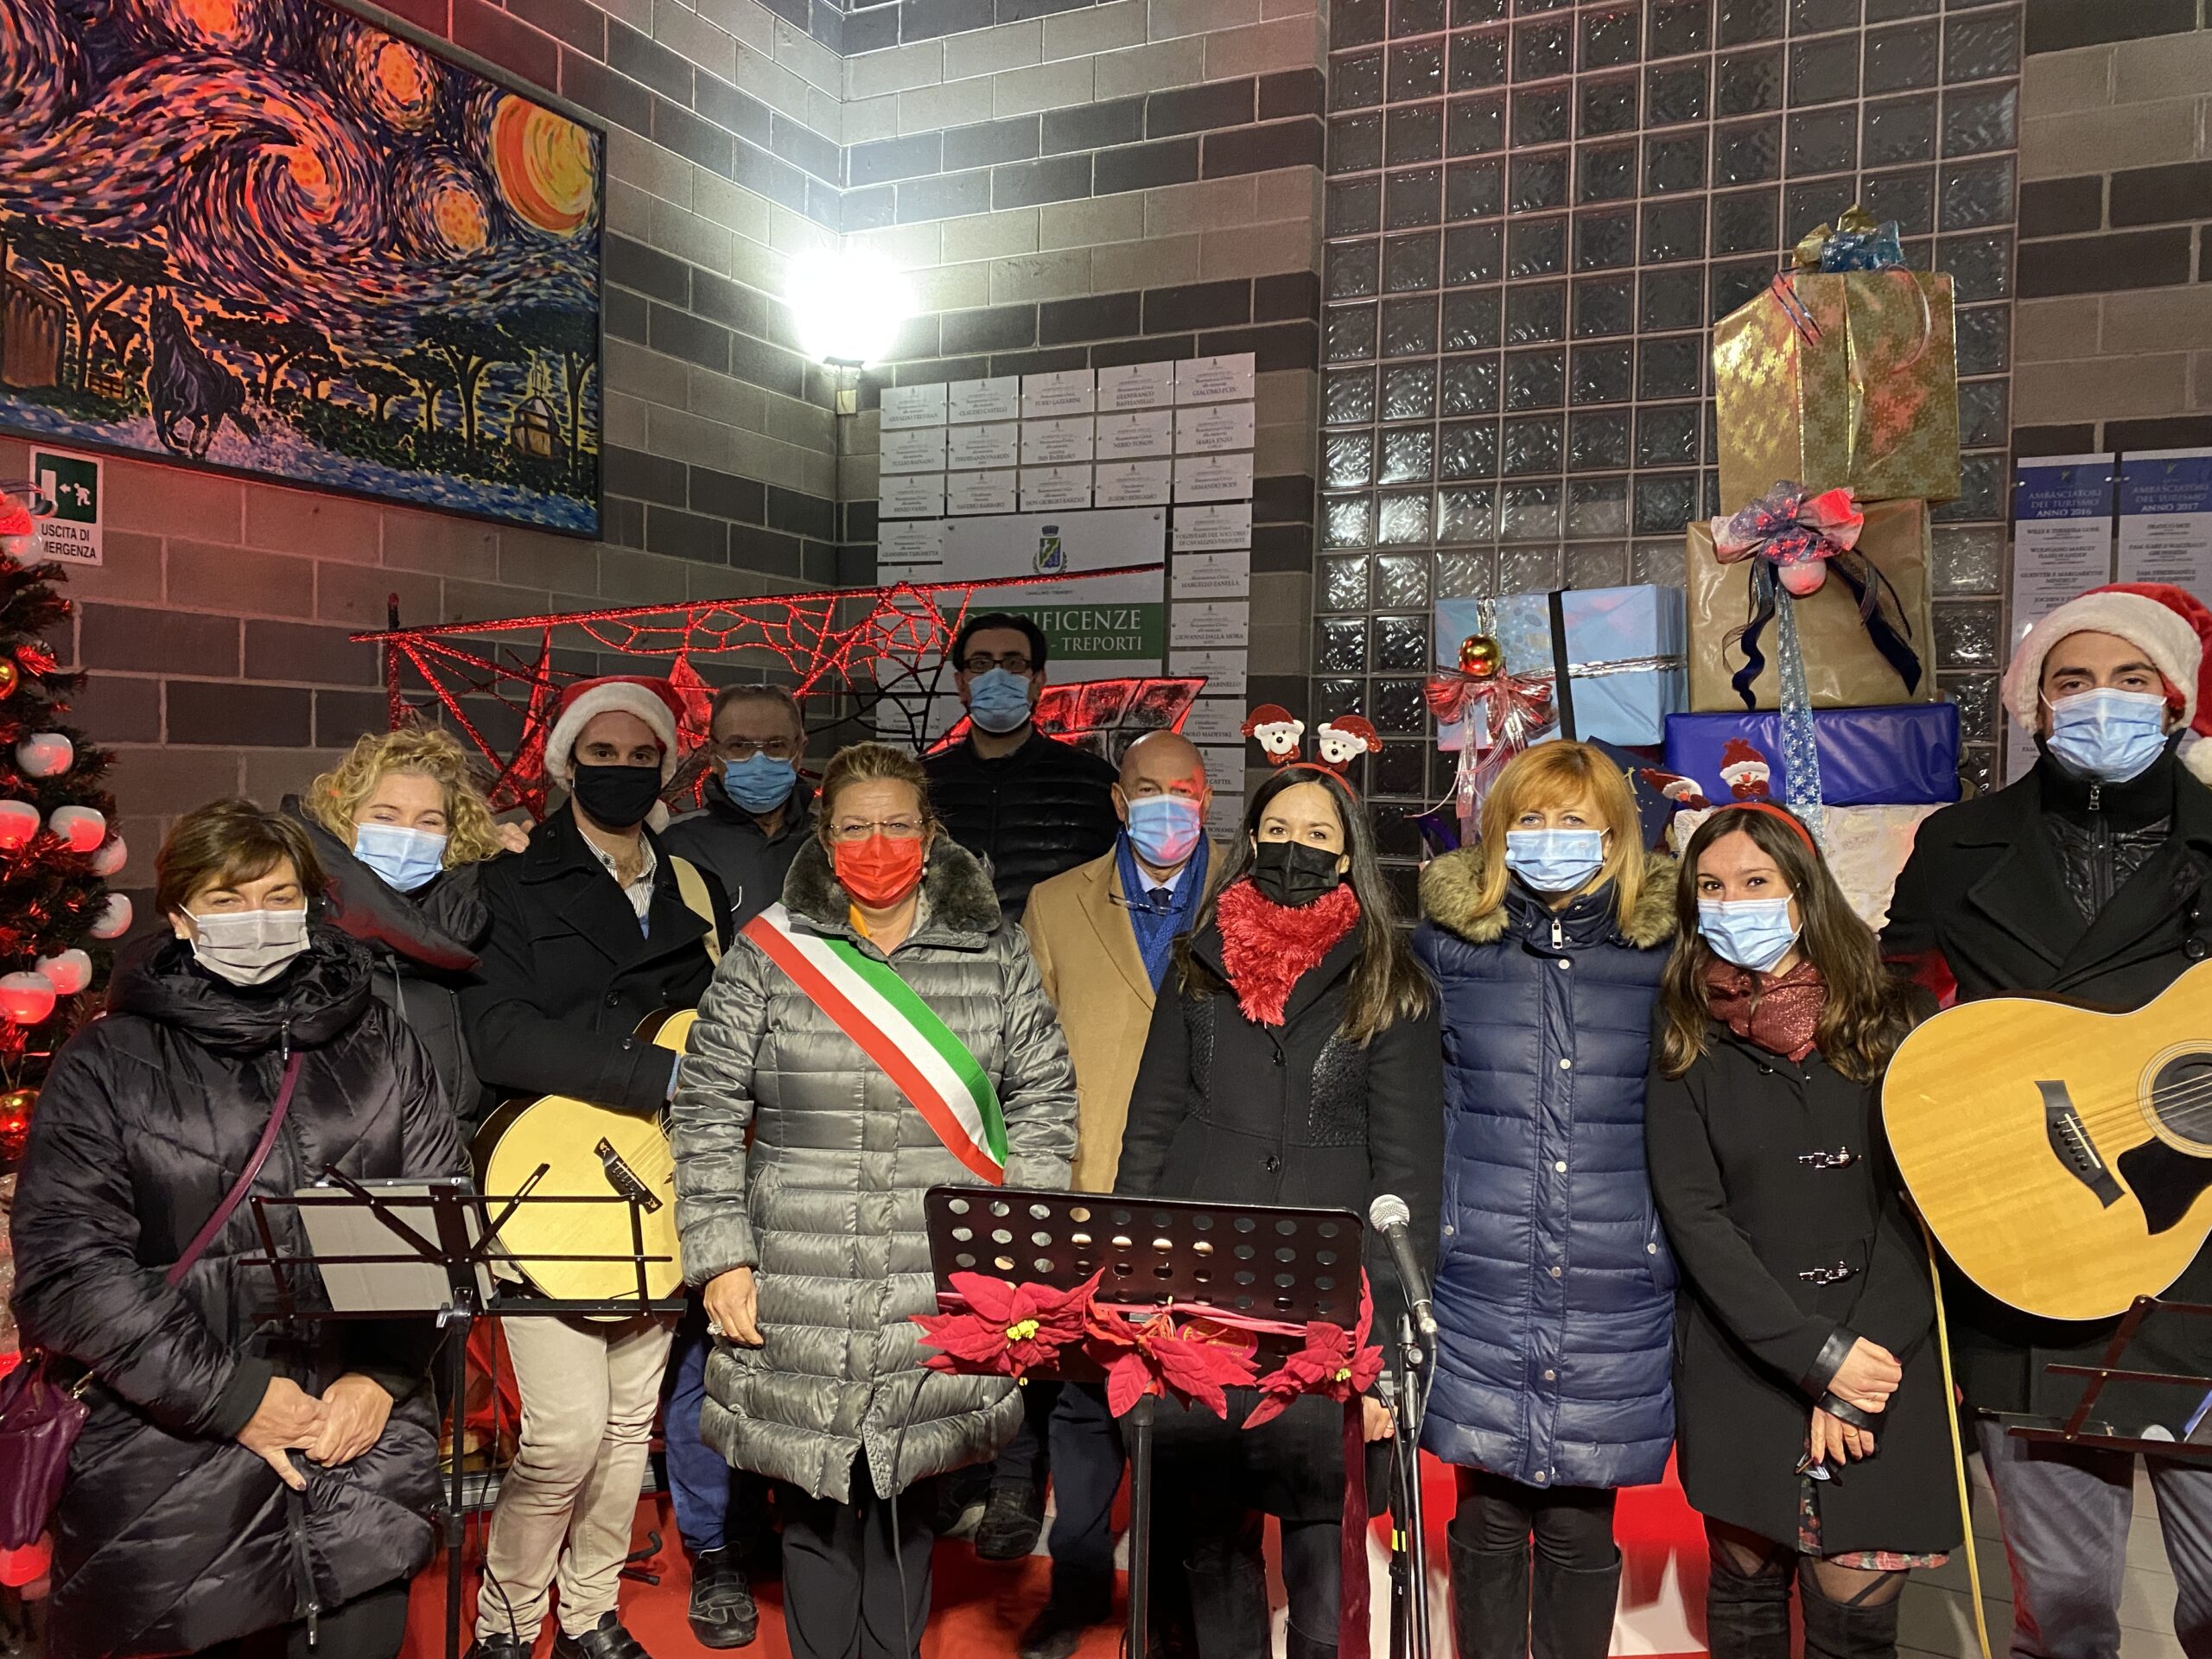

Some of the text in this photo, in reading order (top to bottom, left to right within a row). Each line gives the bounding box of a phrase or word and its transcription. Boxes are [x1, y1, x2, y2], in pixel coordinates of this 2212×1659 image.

[2028, 488, 2102, 500] AMBASCIATORI
[2132, 484, 2209, 495] AMBASCIATORI
[2053, 499, 2100, 508] TURISMO
[2141, 502, 2199, 512] ANNO 2017
[2036, 509, 2069, 518] ANNO
[41, 524, 90, 542] USCITA DI
[1061, 636, 1142, 652] TREPORTI
